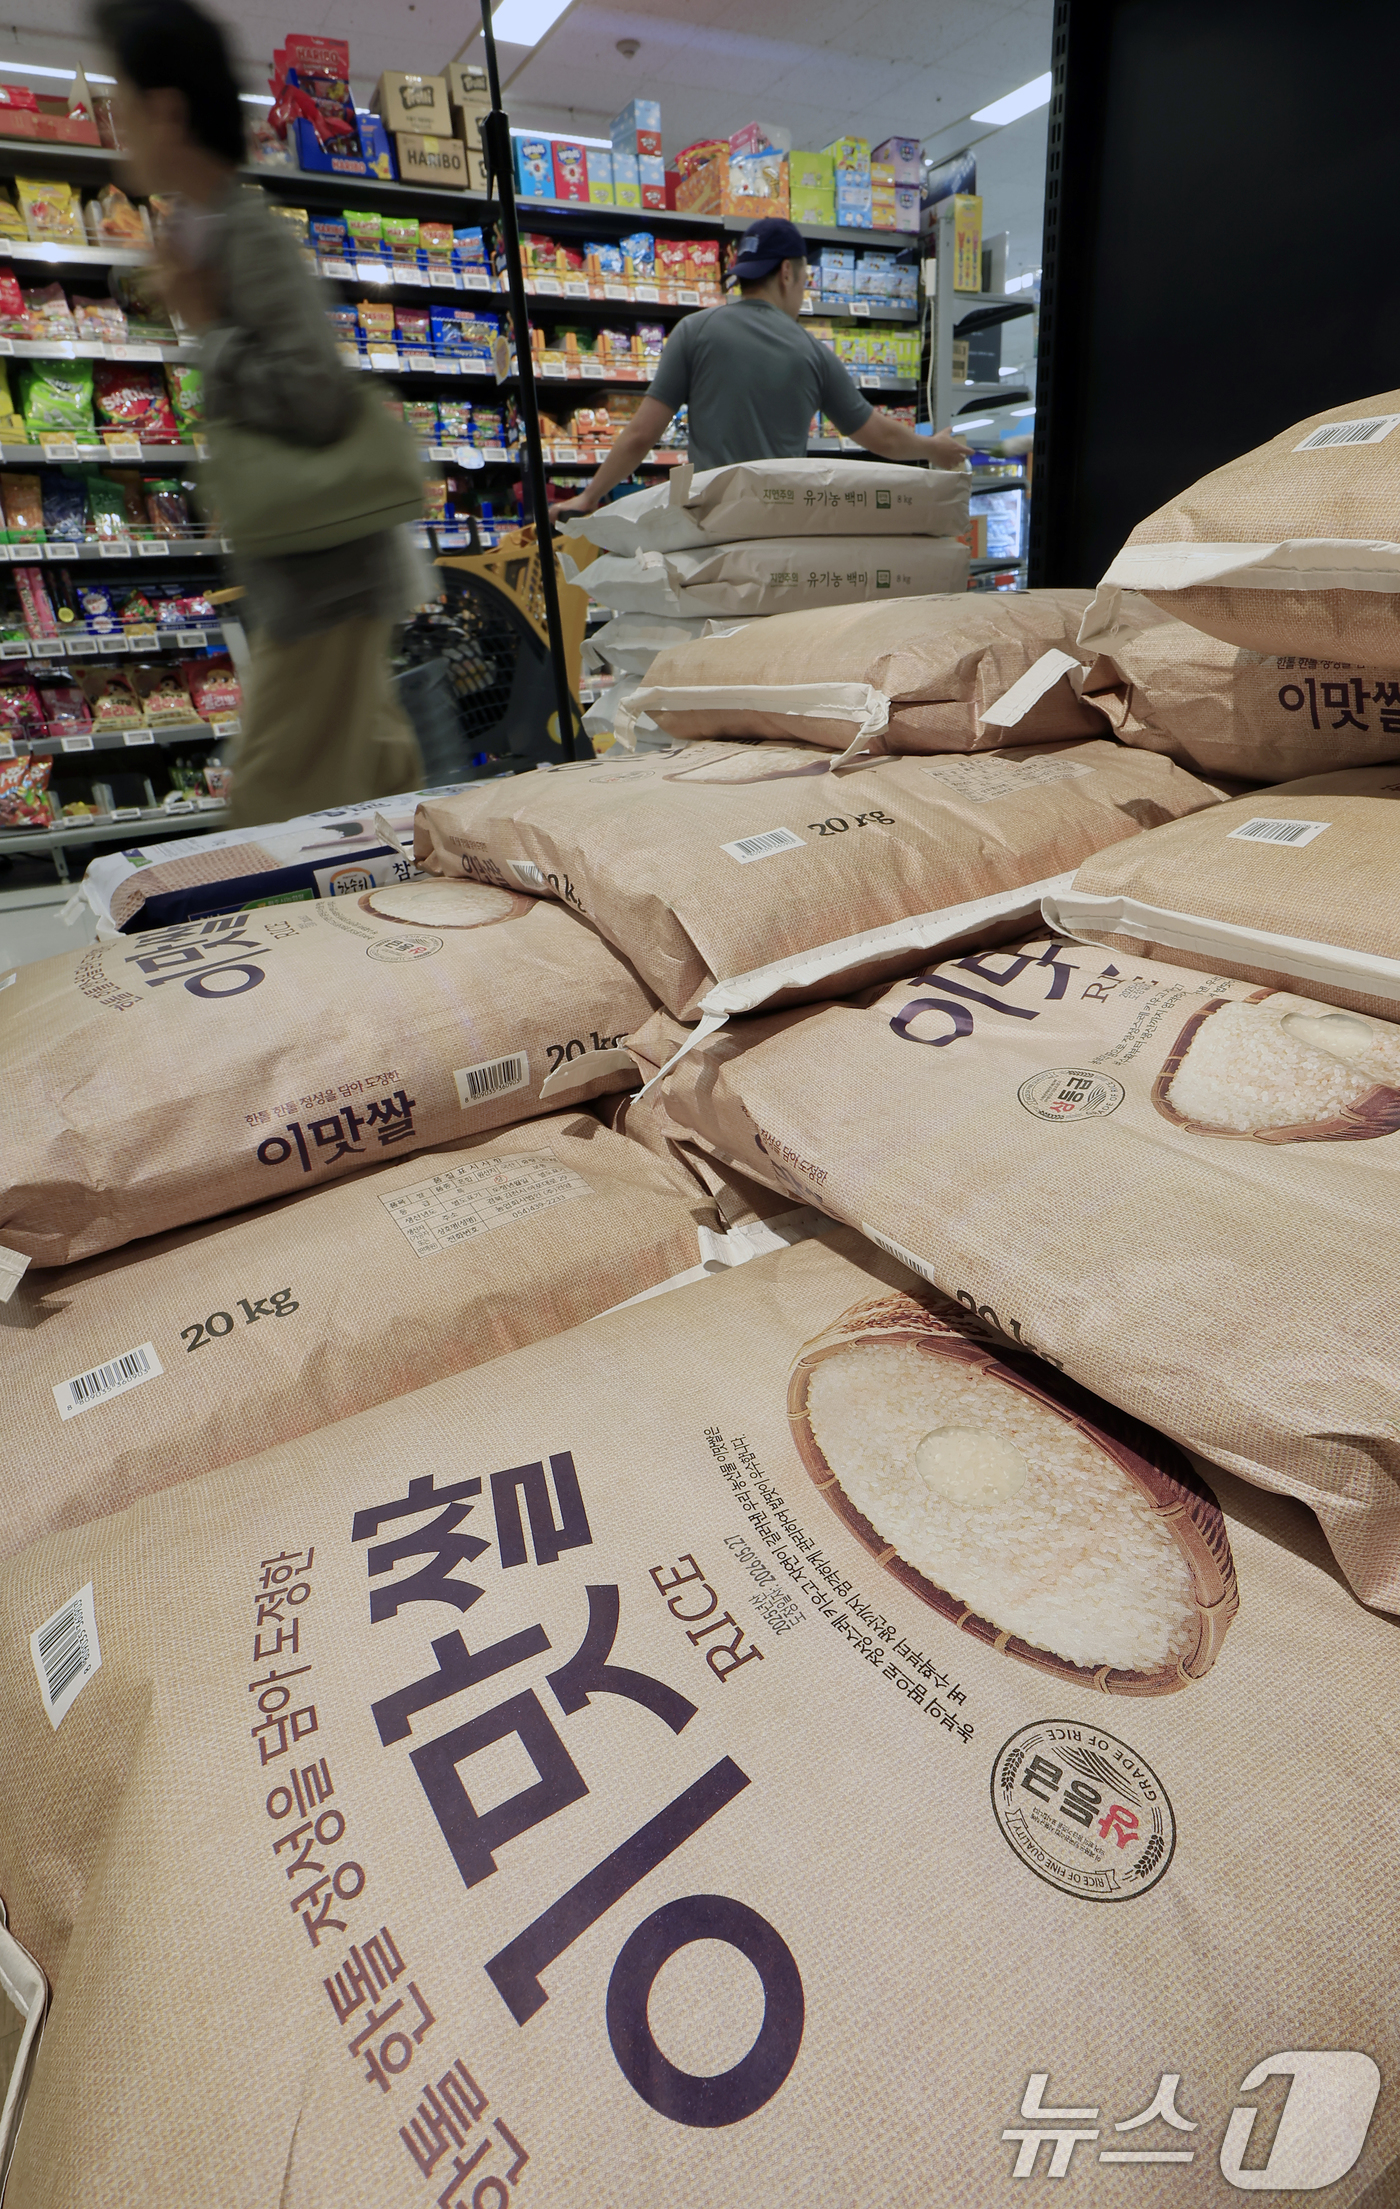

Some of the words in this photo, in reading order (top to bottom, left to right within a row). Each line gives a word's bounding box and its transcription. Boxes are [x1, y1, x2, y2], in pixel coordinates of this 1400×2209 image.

[332, 158, 367, 174] HARIBO
[407, 150, 462, 170] HARIBO
[803, 490, 841, 507] 유기농
[844, 490, 867, 507] 백미
[902, 494, 913, 505] kg
[807, 572, 843, 588] 유기농
[846, 571, 868, 587] 백미
[902, 573, 911, 585] kg
[807, 817, 850, 836] 20
[245, 1109, 272, 1128] 한톨
[273, 1101, 299, 1118] 한톨
[300, 1088, 338, 1109] 정성을
[338, 1080, 364, 1098] 담아
[365, 1069, 402, 1089] 도정한
[473, 1087, 496, 1101] 809035
[1049, 1076, 1093, 1113] 상등급
[257, 1089, 416, 1173] 이맛쌀
[782, 1145, 801, 1169] 담아
[798, 1159, 829, 1187] 도정한
[405, 1208, 436, 1223] 생산년도
[451, 1192, 483, 1207] 별도표기
[492, 1177, 530, 1193] 도정년월일
[446, 1226, 480, 1243] 전화번호
[180, 1311, 235, 1352] 20
[236, 1287, 300, 1325] kg
[79, 1386, 114, 1406] 809035
[115, 1367, 150, 1389] 360903
[704, 1427, 729, 1462] 이맛쌀은
[730, 1436, 765, 1479] 우수합니다.
[719, 1462, 746, 1491] 농산물
[754, 1479, 784, 1511] 밥맛이
[734, 1490, 759, 1511] 우리
[748, 1510, 782, 1547] 길러낸
[773, 1509, 815, 1553] 관리하여
[723, 1535, 776, 1587] 2026.05.27
[771, 1545, 807, 1583] 자연이
[806, 1550, 853, 1597] 엄격하게
[253, 1546, 315, 1661] 도정한
[648, 1553, 765, 1683] RICE
[748, 1592, 791, 1636] 2025년산
[767, 1587, 806, 1626] 도정일자:
[801, 1580, 838, 1618] 키우고
[845, 1593, 896, 1641] 생산까지
[831, 1613, 884, 1667] 정성스레
[83, 1664, 92, 1675] 8
[892, 1638, 949, 1688] 수확부터
[882, 1662, 928, 1705] 땀으로
[946, 1683, 967, 1706] 벼
[250, 1661, 321, 1766] 담아
[924, 1697, 974, 1744] 농부의
[1045, 1730, 1082, 1742] RICE
[1088, 1737, 1109, 1751] OF
[351, 1450, 805, 2129] 이맛쌀
[1112, 1749, 1156, 1801] GRADE
[1020, 1754, 1139, 1849] 상등급
[264, 1757, 367, 1948] 정성을
[1013, 1826, 1045, 1862] QUALITY
[1045, 1859, 1066, 1877] FINE
[1067, 1872, 1081, 1884] OF
[1083, 1876, 1104, 1887] RICE
[322, 1927, 437, 2094] 한톨
